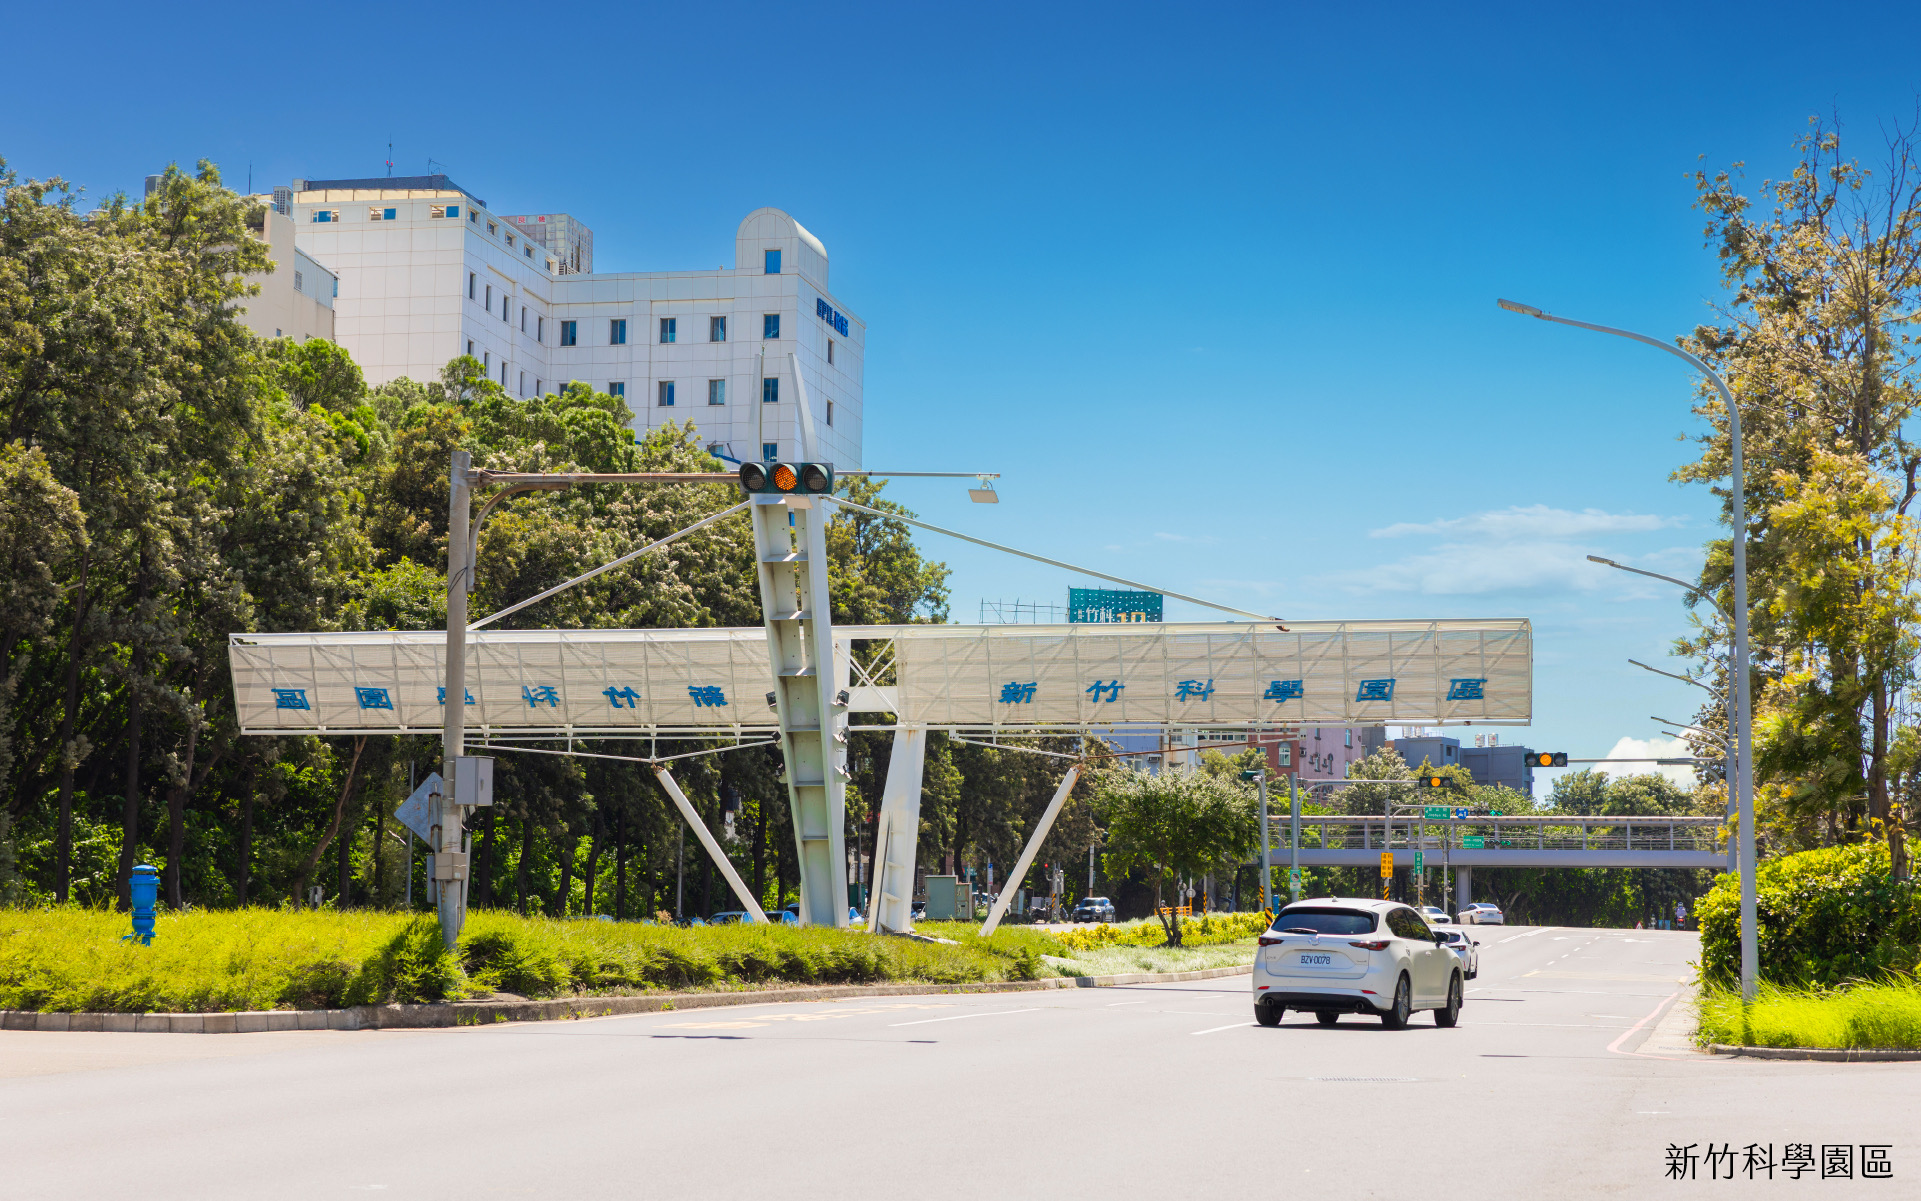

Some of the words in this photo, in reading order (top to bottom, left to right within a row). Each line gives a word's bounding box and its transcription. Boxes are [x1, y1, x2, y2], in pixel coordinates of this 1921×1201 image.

[998, 678, 1488, 705] 新竹科學園區
